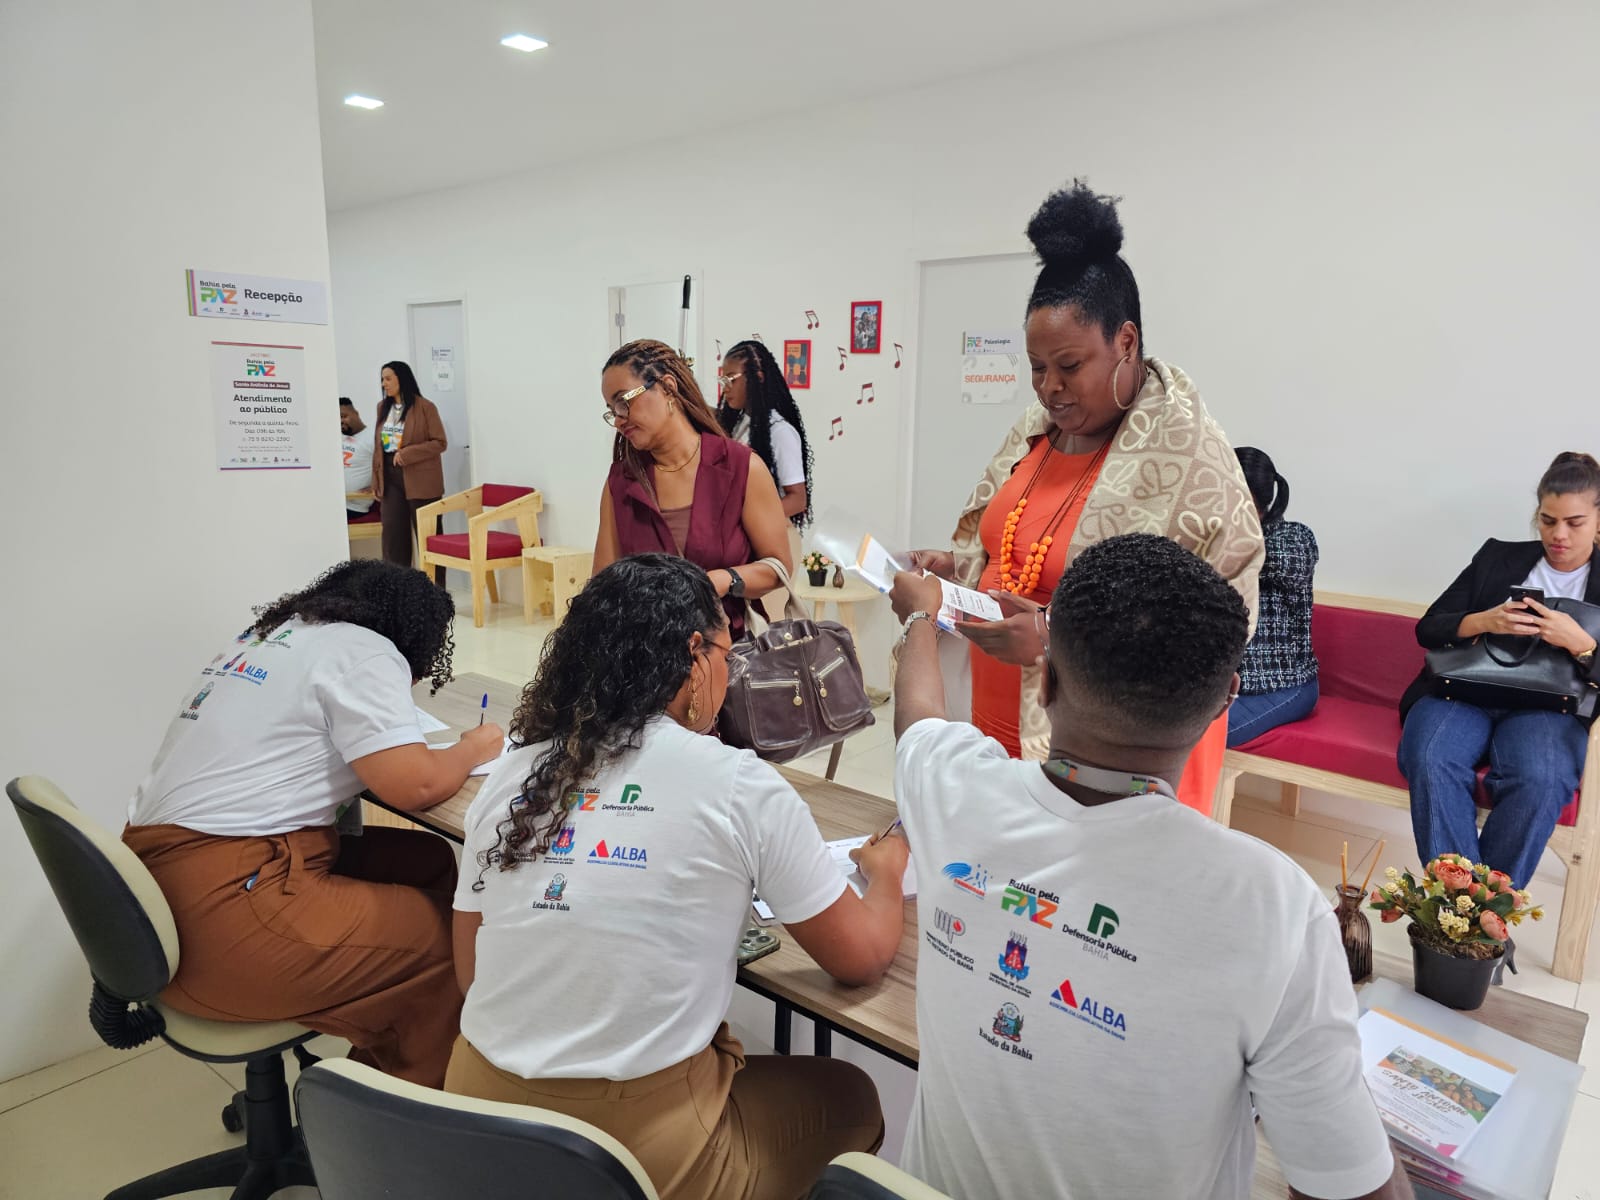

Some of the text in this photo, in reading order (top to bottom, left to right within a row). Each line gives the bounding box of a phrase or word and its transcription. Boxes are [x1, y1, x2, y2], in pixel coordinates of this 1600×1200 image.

[200, 287, 238, 305] PAZ
[244, 288, 303, 305] Recepção
[246, 364, 277, 377] PAZ
[964, 374, 1017, 384] SEGURANÇA
[233, 394, 293, 403] Atendimento
[253, 406, 288, 414] público
[244, 664, 268, 681] ALBA
[602, 803, 655, 812] Defensoria Pública
[611, 846, 647, 863] ALBA
[1008, 878, 1060, 904] Bahia pela
[532, 901, 549, 910] Estado
[556, 902, 570, 911] Bahia
[1001, 886, 1058, 929] PAZ
[1062, 924, 1137, 963] Defensoria Pública
[1082, 942, 1109, 962] BAHIA
[1080, 997, 1126, 1032] ALBA
[978, 1027, 1033, 1061] Estado da Bahia
